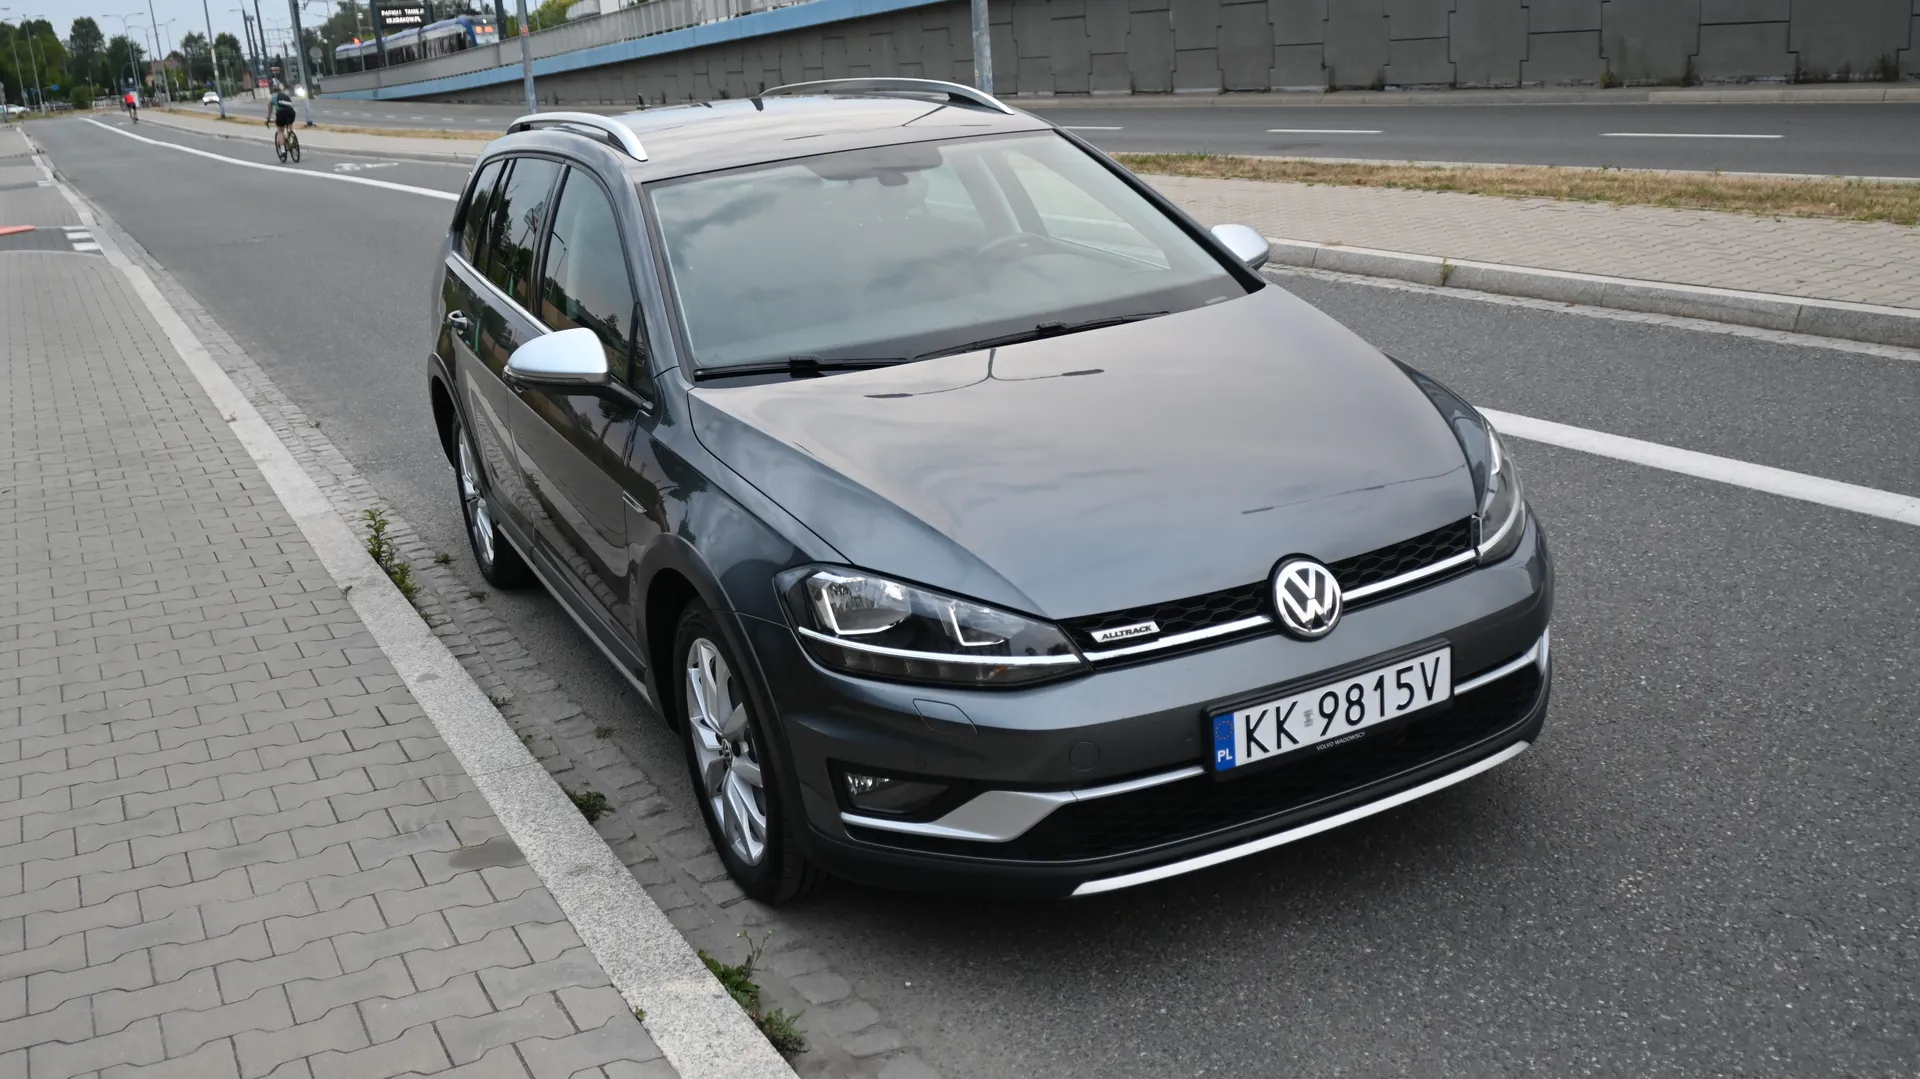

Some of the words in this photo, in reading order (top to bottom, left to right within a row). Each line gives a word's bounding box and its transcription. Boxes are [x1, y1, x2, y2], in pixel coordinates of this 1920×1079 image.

[1101, 624, 1152, 640] ALLTRACK
[1245, 700, 1300, 758] KK
[1319, 656, 1440, 738] 9815V
[1316, 741, 1334, 751] VOLVO
[1334, 731, 1366, 745] WADOWSCY
[1217, 748, 1233, 763] PL
